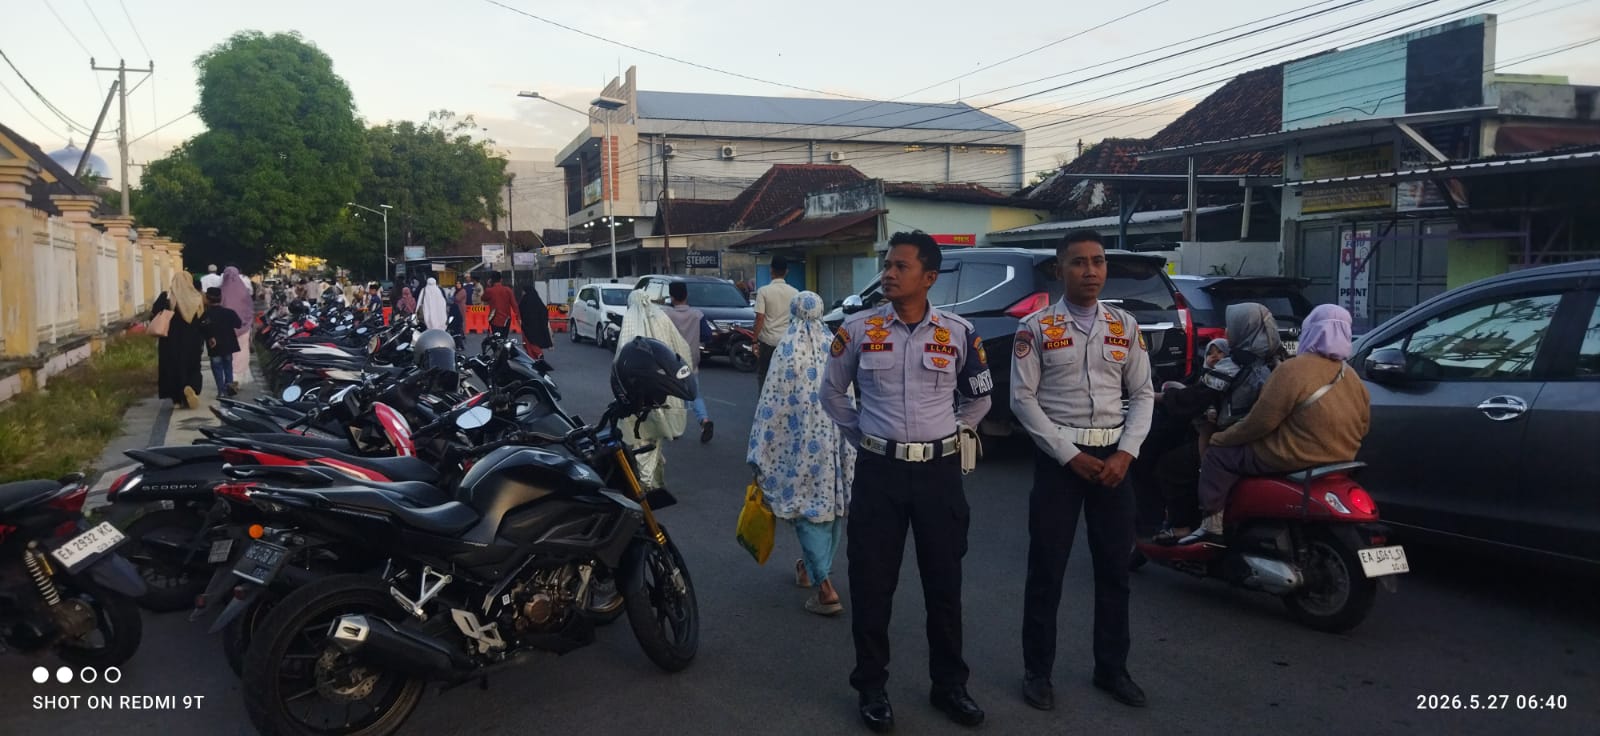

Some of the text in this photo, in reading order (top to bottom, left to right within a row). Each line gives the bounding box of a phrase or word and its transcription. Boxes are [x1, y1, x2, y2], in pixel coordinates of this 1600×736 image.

[686, 255, 718, 265] STEMPEL
[1047, 340, 1069, 349] RONI
[1108, 337, 1127, 346] LLAJ
[930, 345, 952, 354] LLAJ
[57, 548, 75, 560] EA
[72, 532, 99, 551] 2932
[1361, 551, 1375, 563] EA
